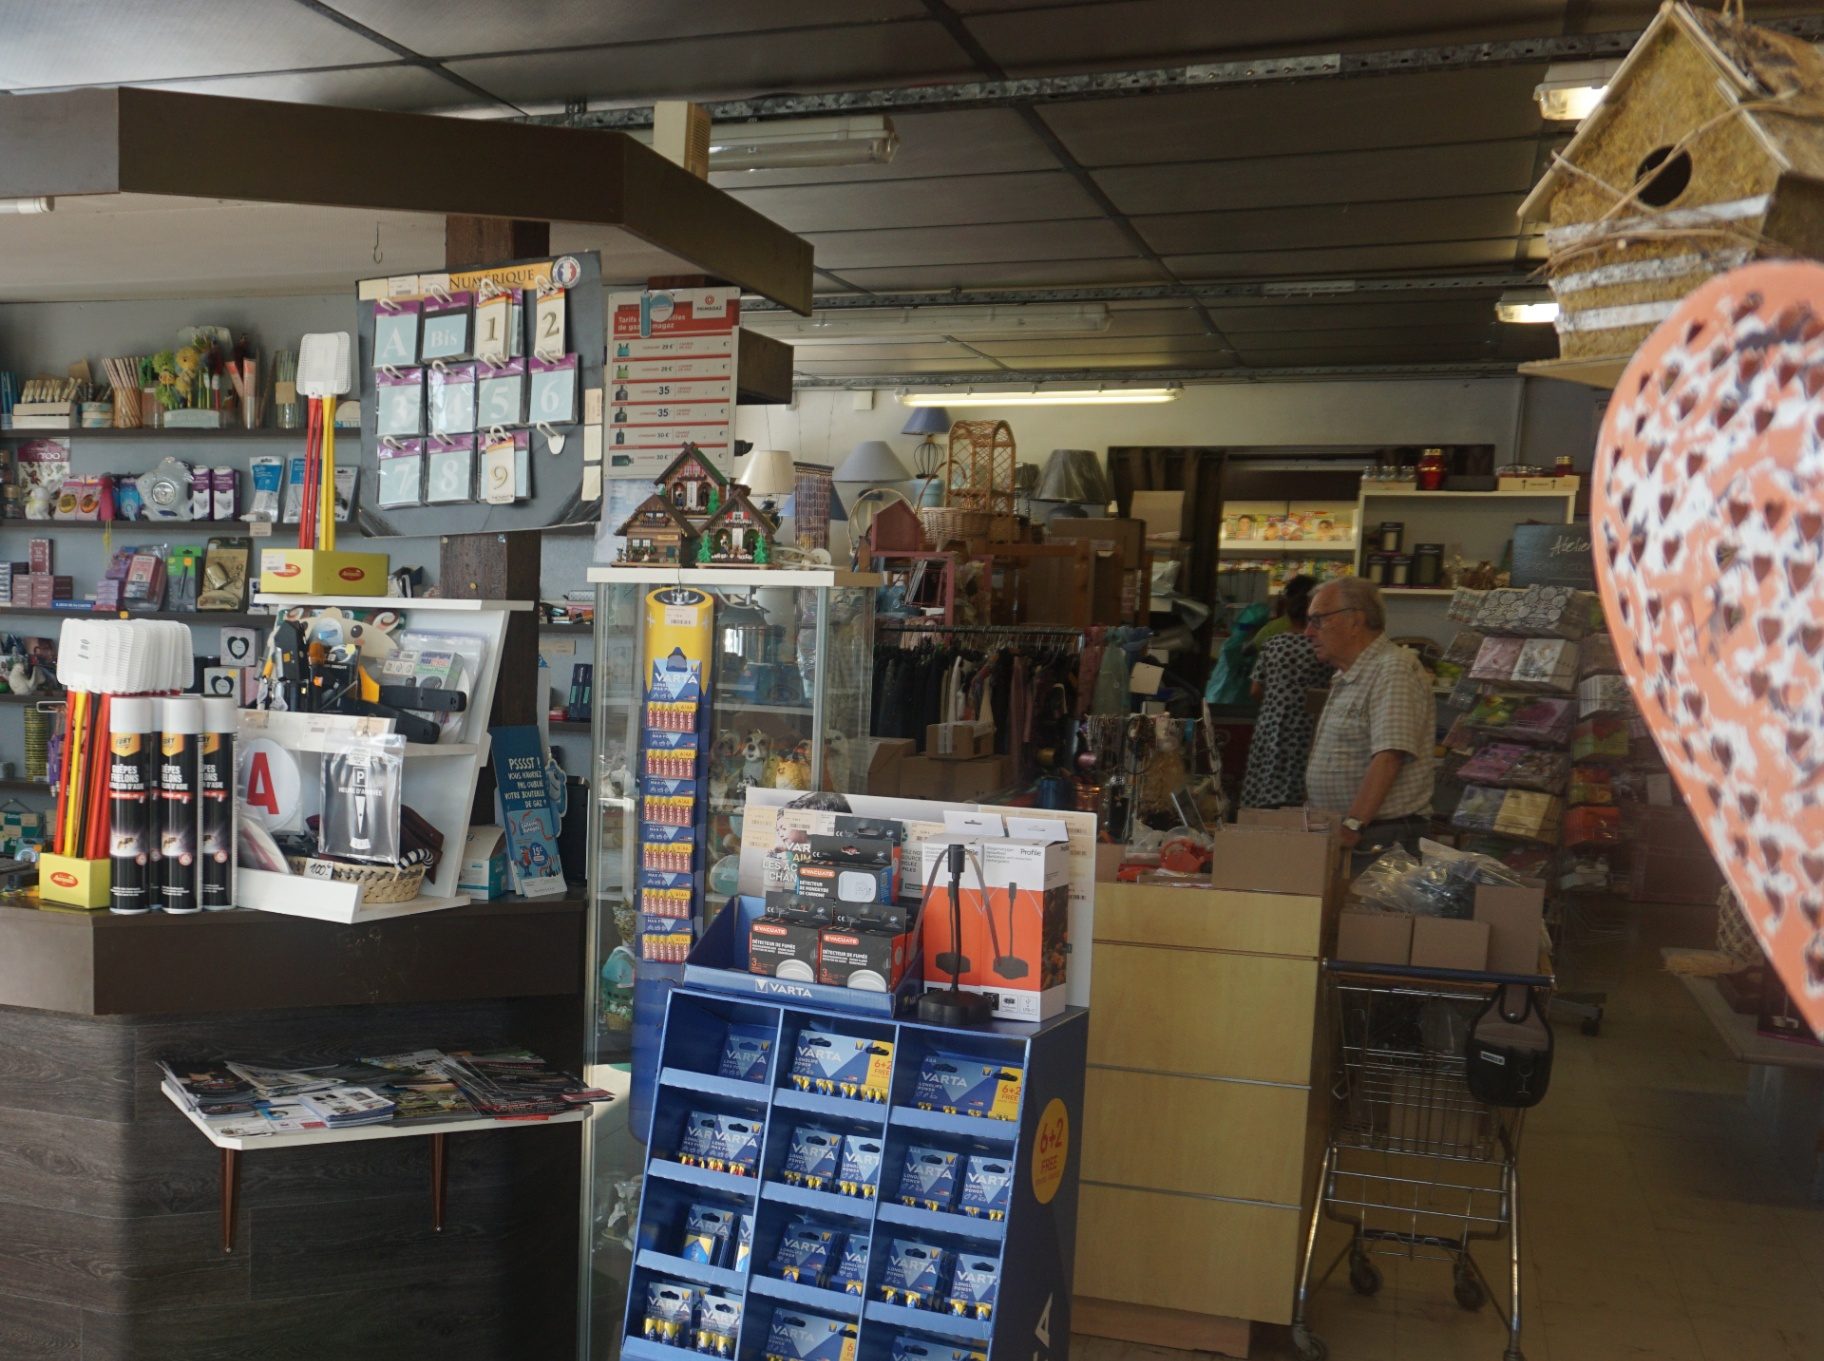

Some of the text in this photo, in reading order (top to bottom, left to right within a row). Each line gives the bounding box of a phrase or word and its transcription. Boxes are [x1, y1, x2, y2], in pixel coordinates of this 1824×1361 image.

[486, 316, 498, 341] 1
[543, 311, 560, 338] 2
[383, 327, 407, 358] A
[431, 329, 457, 347] Bis
[540, 380, 559, 413] 6
[658, 386, 670, 395] 35
[658, 408, 668, 417] 35
[442, 460, 460, 492] 8
[493, 464, 508, 489] 9
[655, 673, 698, 684] VARTA
[246, 751, 280, 815] A
[356, 771, 365, 783] P
[786, 842, 811, 853] VAR
[1020, 848, 1042, 856] Profile
[763, 860, 782, 870] LES
[792, 853, 812, 862] AIM
[768, 872, 798, 883] CHAN
[801, 868, 834, 877] EVACUATE
[754, 925, 786, 935] EVACUATE
[825, 935, 858, 944] EVACUATE
[770, 983, 813, 998] VARTA
[726, 1050, 767, 1065] VARTA
[797, 1046, 842, 1062] VARTA
[921, 1072, 968, 1087] VARTA
[1001, 1085, 1022, 1095] 6+2
[688, 1126, 712, 1140] VAR
[714, 1131, 757, 1147] VARTA
[1039, 1117, 1064, 1153] 6+2
[792, 1143, 835, 1160] VARTA
[845, 1152, 880, 1165] VART
[906, 1163, 952, 1179] VARTA
[1041, 1155, 1058, 1173] FREE
[784, 1238, 826, 1255] VARTA
[890, 1255, 936, 1275] VARTA
[957, 1270, 997, 1285] VART
[772, 1324, 816, 1342] VARTA
